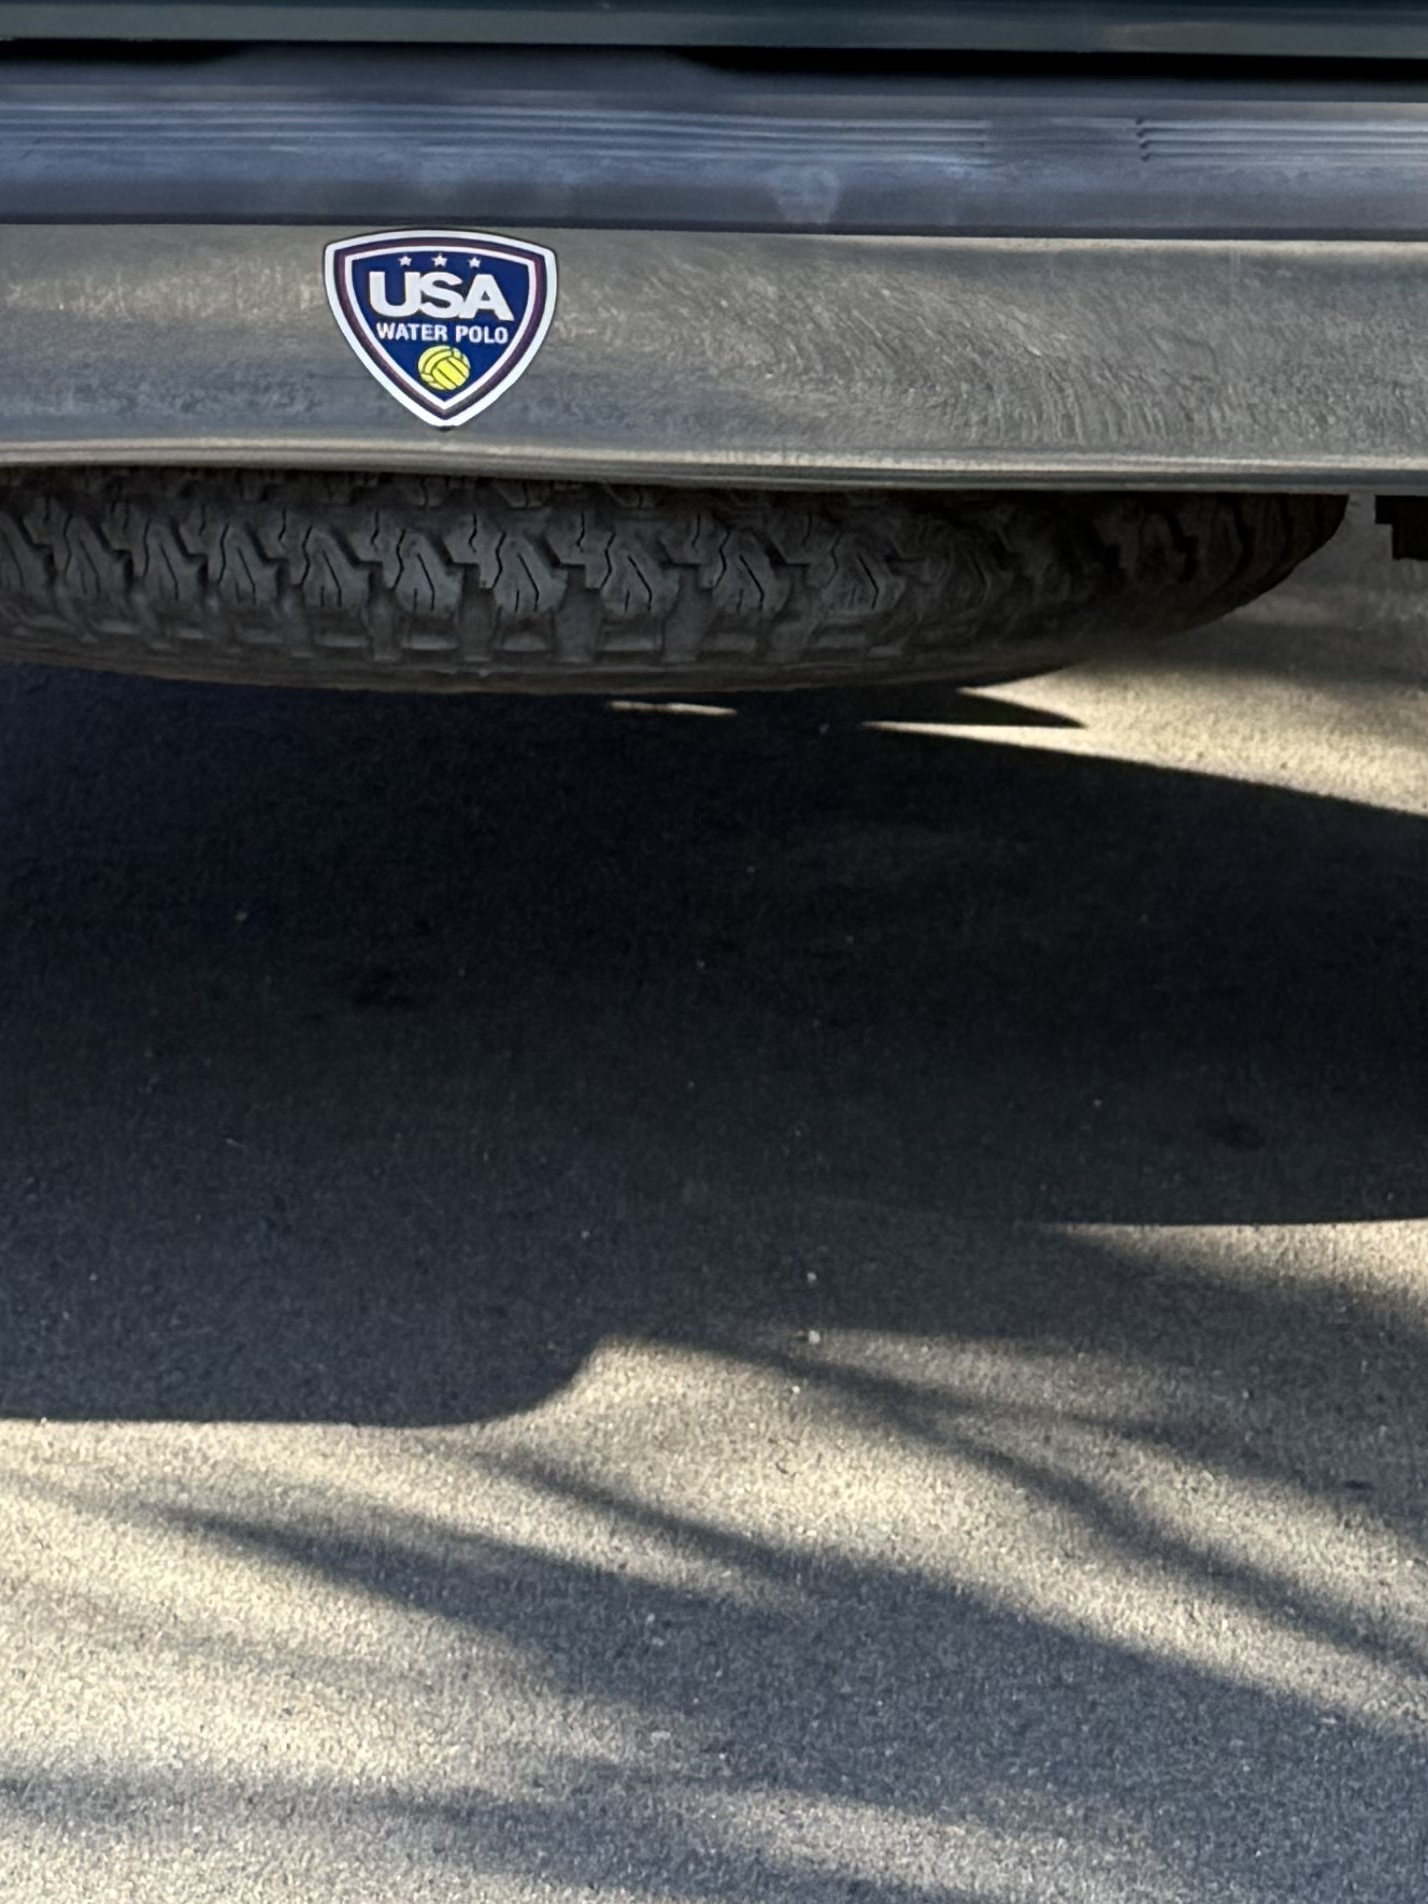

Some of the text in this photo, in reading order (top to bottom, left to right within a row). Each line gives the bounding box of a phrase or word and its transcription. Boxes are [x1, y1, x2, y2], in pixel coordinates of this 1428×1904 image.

[368, 270, 515, 321] USA
[376, 322, 509, 345] WATER POLO
